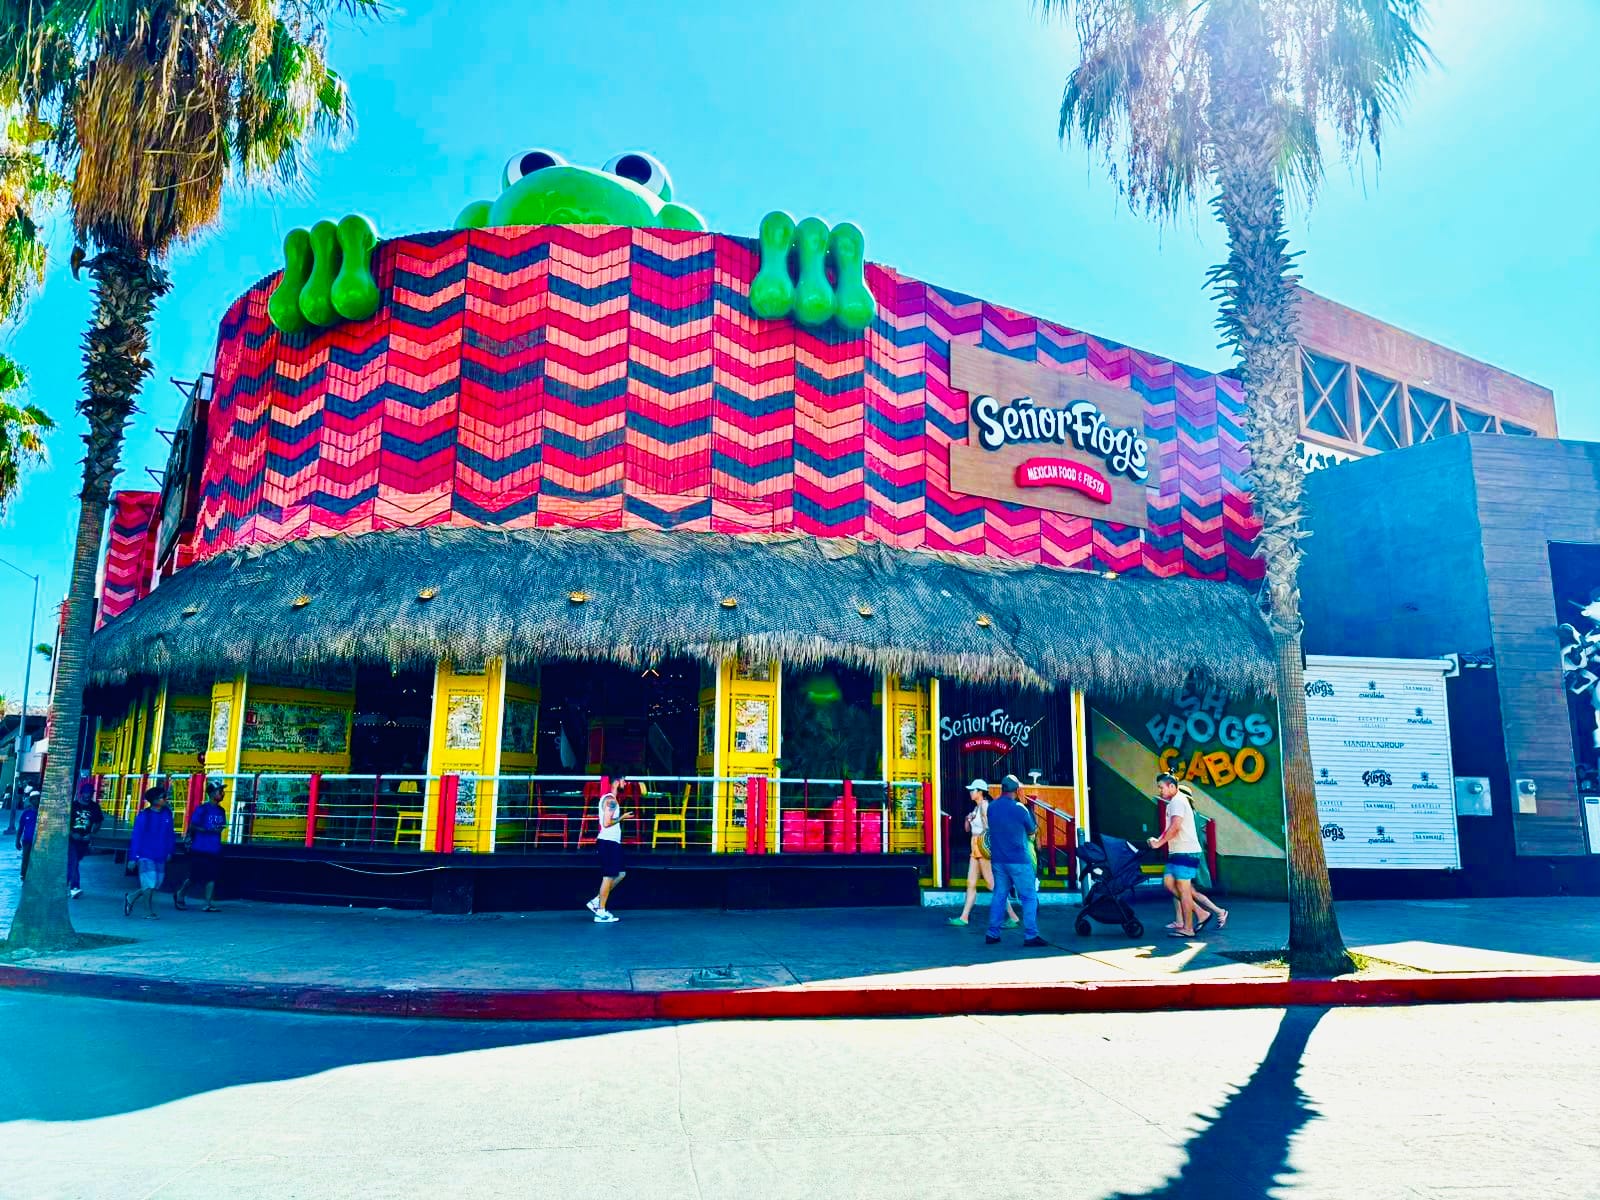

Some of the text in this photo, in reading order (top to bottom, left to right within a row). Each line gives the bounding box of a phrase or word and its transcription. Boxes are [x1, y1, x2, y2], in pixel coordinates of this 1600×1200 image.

[974, 396, 1150, 479] Señor Frog's
[1027, 465, 1057, 481] MEXICAN
[1058, 465, 1077, 481] FOOD
[1083, 473, 1105, 496] FIESTA
[940, 708, 1031, 747] Señor Frog's
[1145, 711, 1273, 749] FROGS
[1159, 747, 1265, 787] CABO
